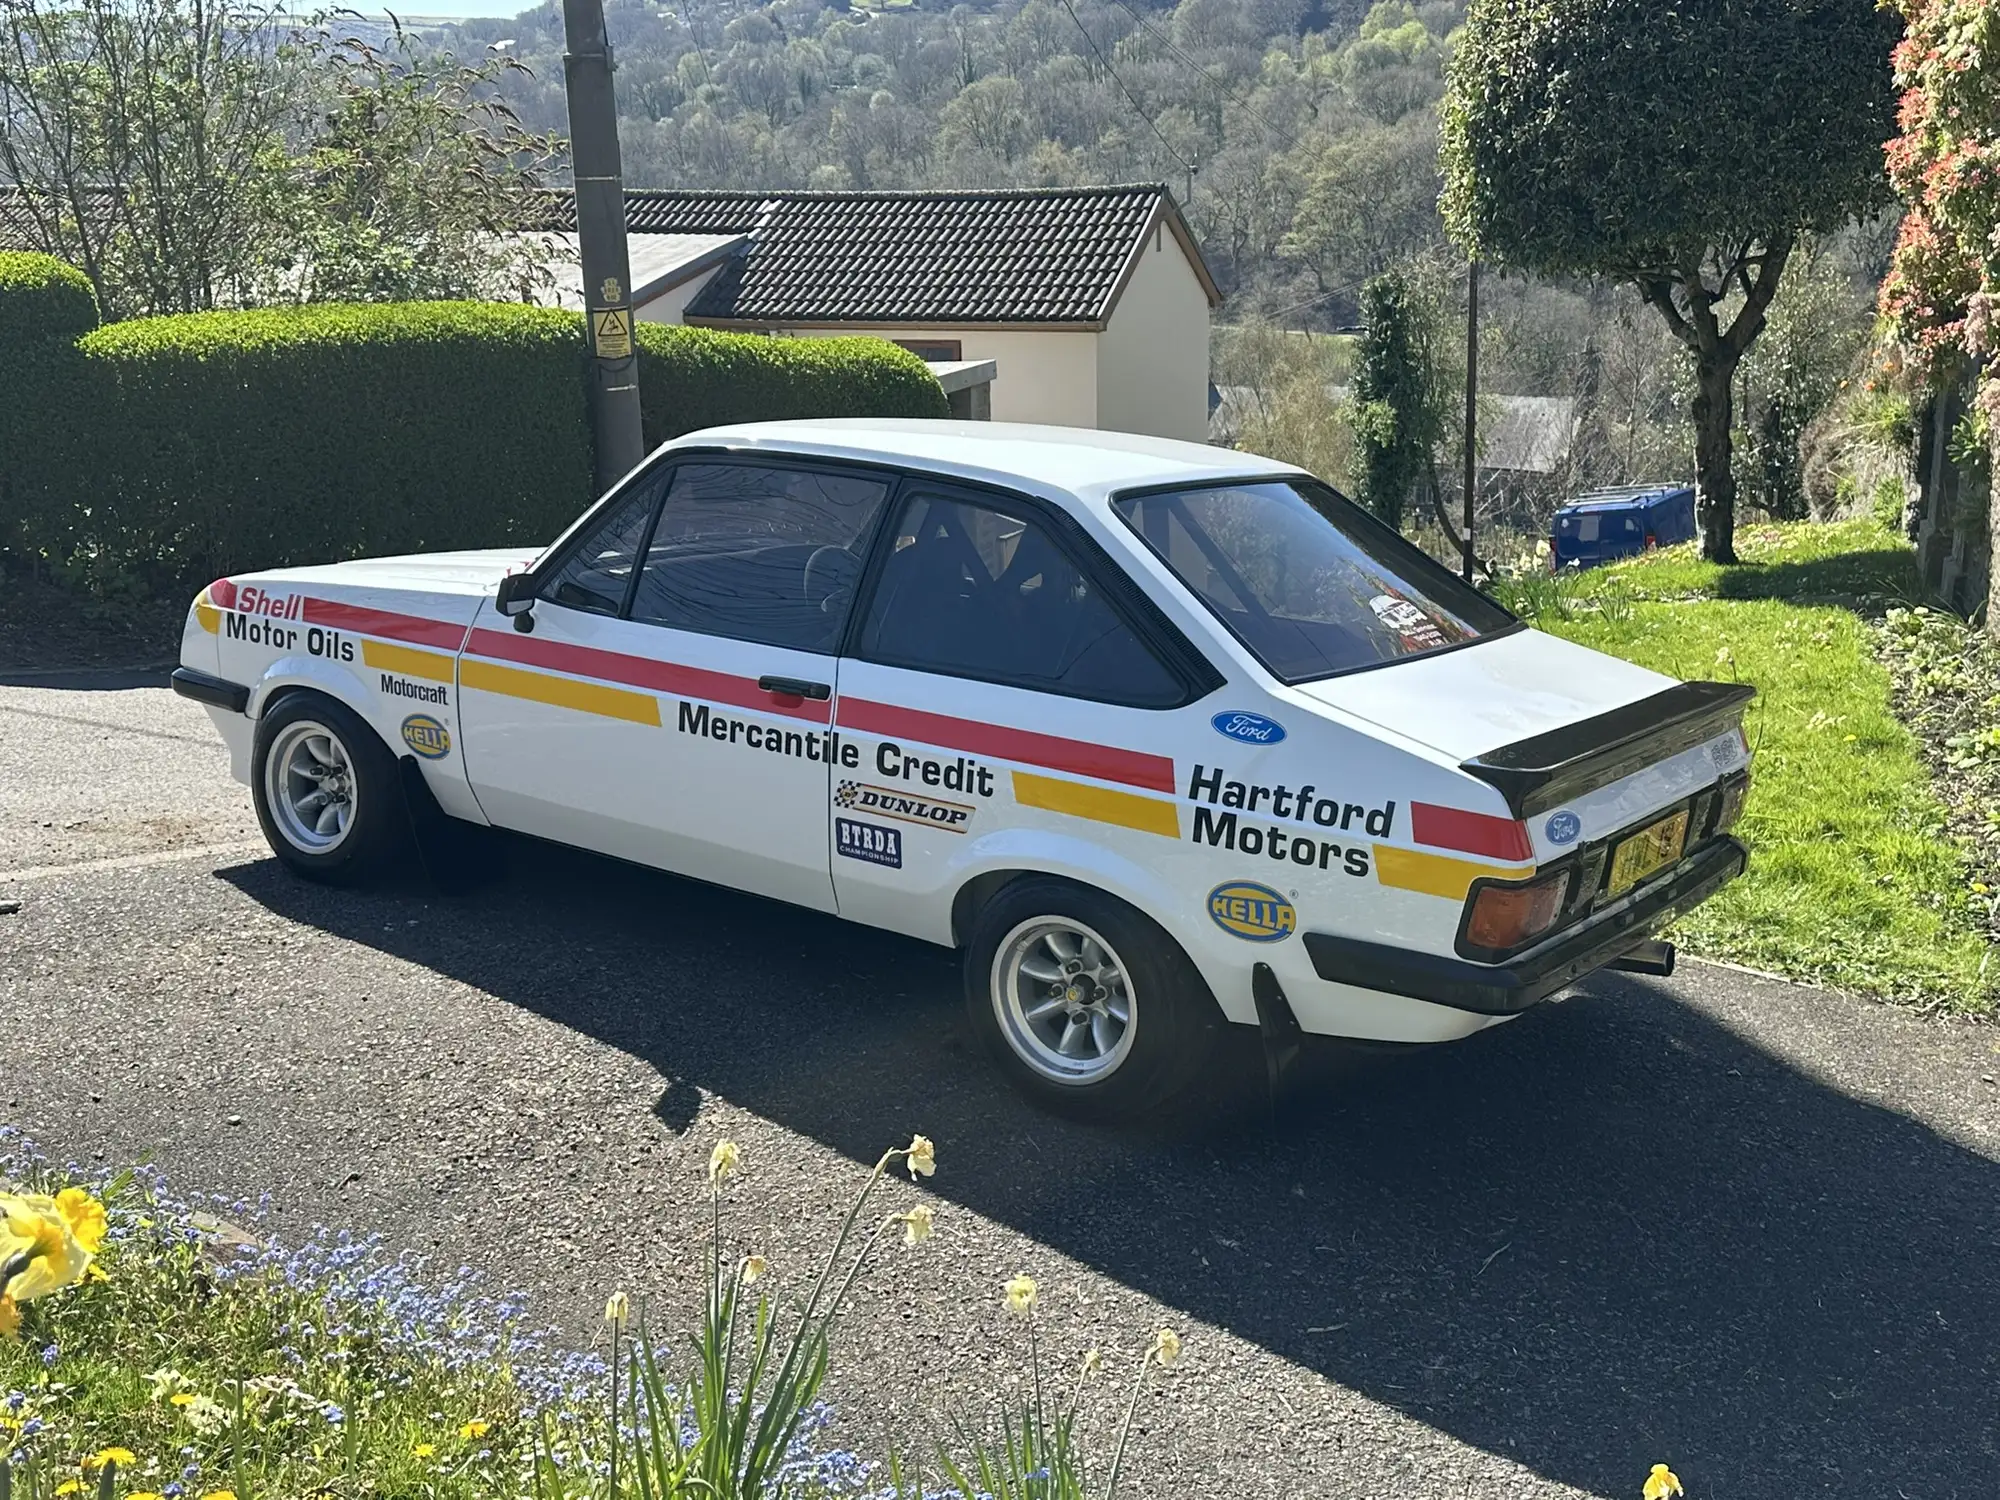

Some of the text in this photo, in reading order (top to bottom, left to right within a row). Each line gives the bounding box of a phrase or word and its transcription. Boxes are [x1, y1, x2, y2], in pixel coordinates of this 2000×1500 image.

[239, 587, 301, 620] Shell
[227, 612, 354, 662] Motor Oils
[381, 674, 449, 706] Motorcraft
[404, 726, 450, 752] HELLA
[1225, 715, 1273, 741] Ford
[678, 701, 994, 798] Mercantile Credit
[860, 790, 967, 825] DUNLOP
[1188, 764, 1396, 838] Hartford
[841, 822, 897, 855] BTRDA
[1192, 806, 1370, 878] Motors
[1553, 817, 1575, 839] Ford
[840, 845, 899, 864] CHAMPIONSHIP
[1212, 895, 1296, 932] HELLA
